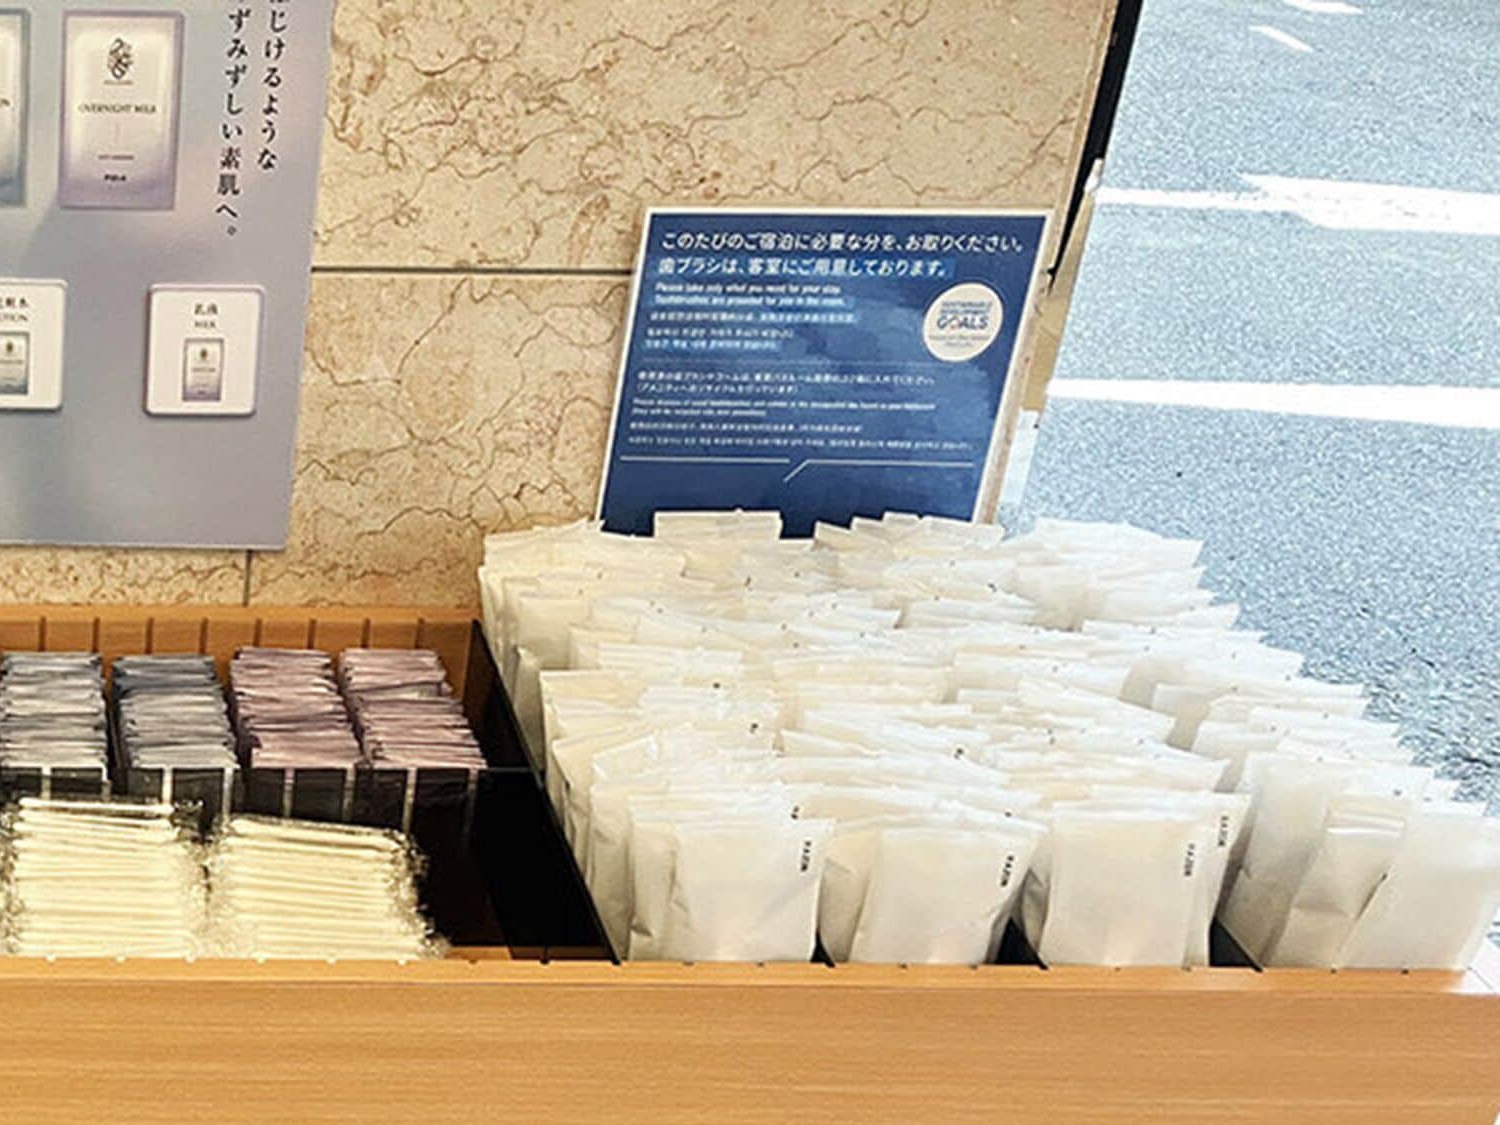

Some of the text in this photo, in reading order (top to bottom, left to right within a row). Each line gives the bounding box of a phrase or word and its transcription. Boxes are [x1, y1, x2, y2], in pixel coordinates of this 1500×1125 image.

[215, 0, 251, 236] ずみずしい素肌へ。
[258, 0, 290, 170] じけるような
